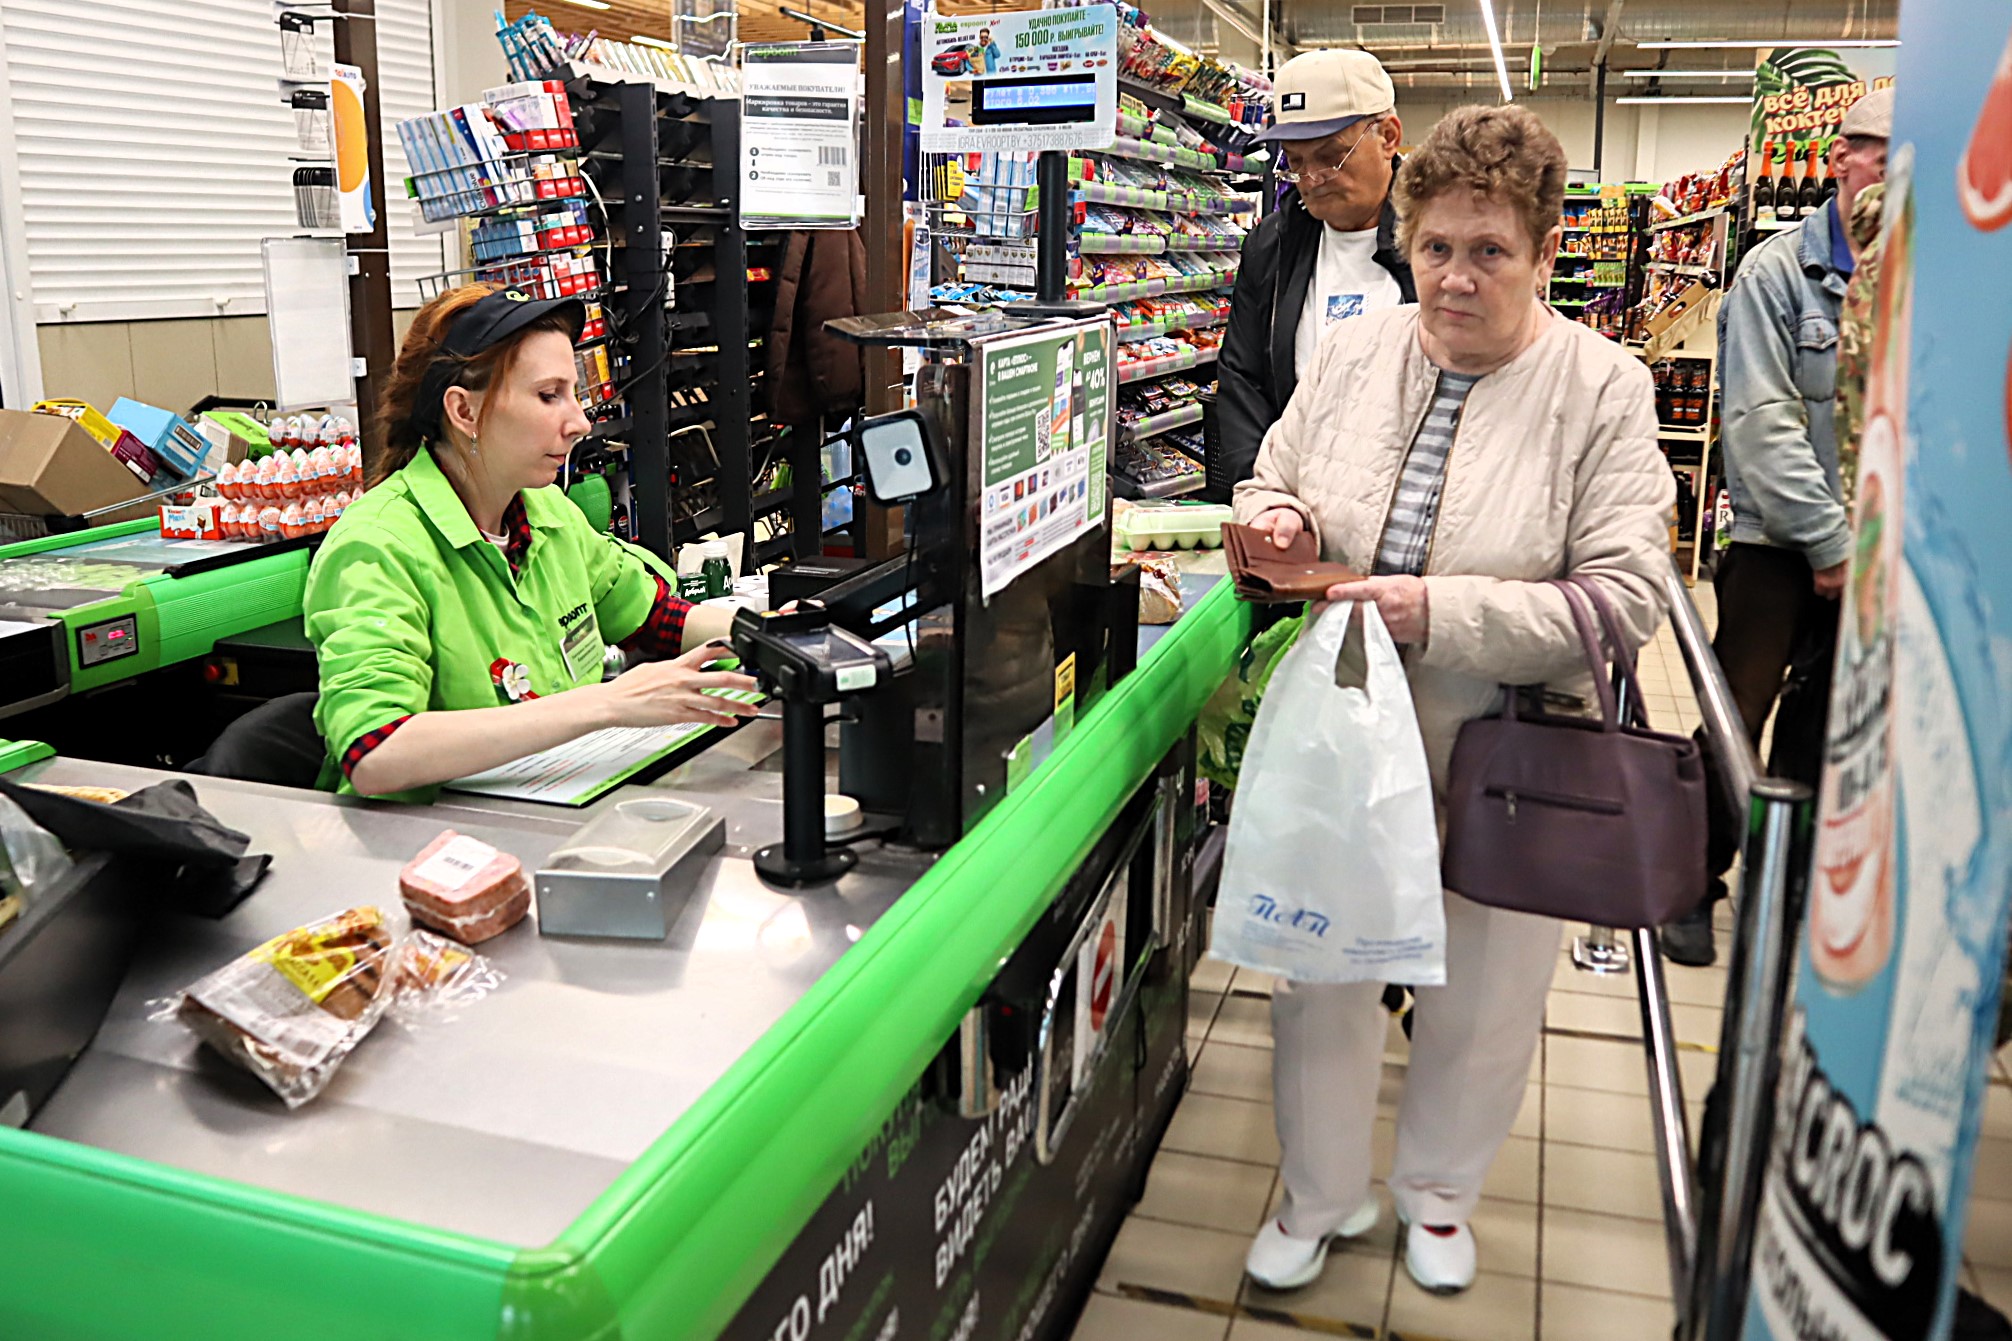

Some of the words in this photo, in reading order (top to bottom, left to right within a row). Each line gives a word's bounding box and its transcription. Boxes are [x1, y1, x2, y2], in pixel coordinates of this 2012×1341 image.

[1028, 16, 1050, 30] УДАЧНО
[1052, 9, 1086, 26] ПОКУПАЙТЕ
[1015, 33, 1030, 49] 150
[1031, 29, 1049, 46] 000
[1057, 24, 1104, 42] ВЫИГРЫВАЙТЕ!
[749, 83, 797, 92] УВАЖАЕМЫЕ
[798, 84, 846, 93] ПОКУПАТЕЛИ!
[1764, 85, 1809, 114] всё
[1814, 81, 1866, 109] для
[934, 1110, 994, 1233] БУДЕМ
[934, 1158, 1002, 1290] ВИДЕТЬ
[816, 1199, 875, 1325] ДНЯ!
